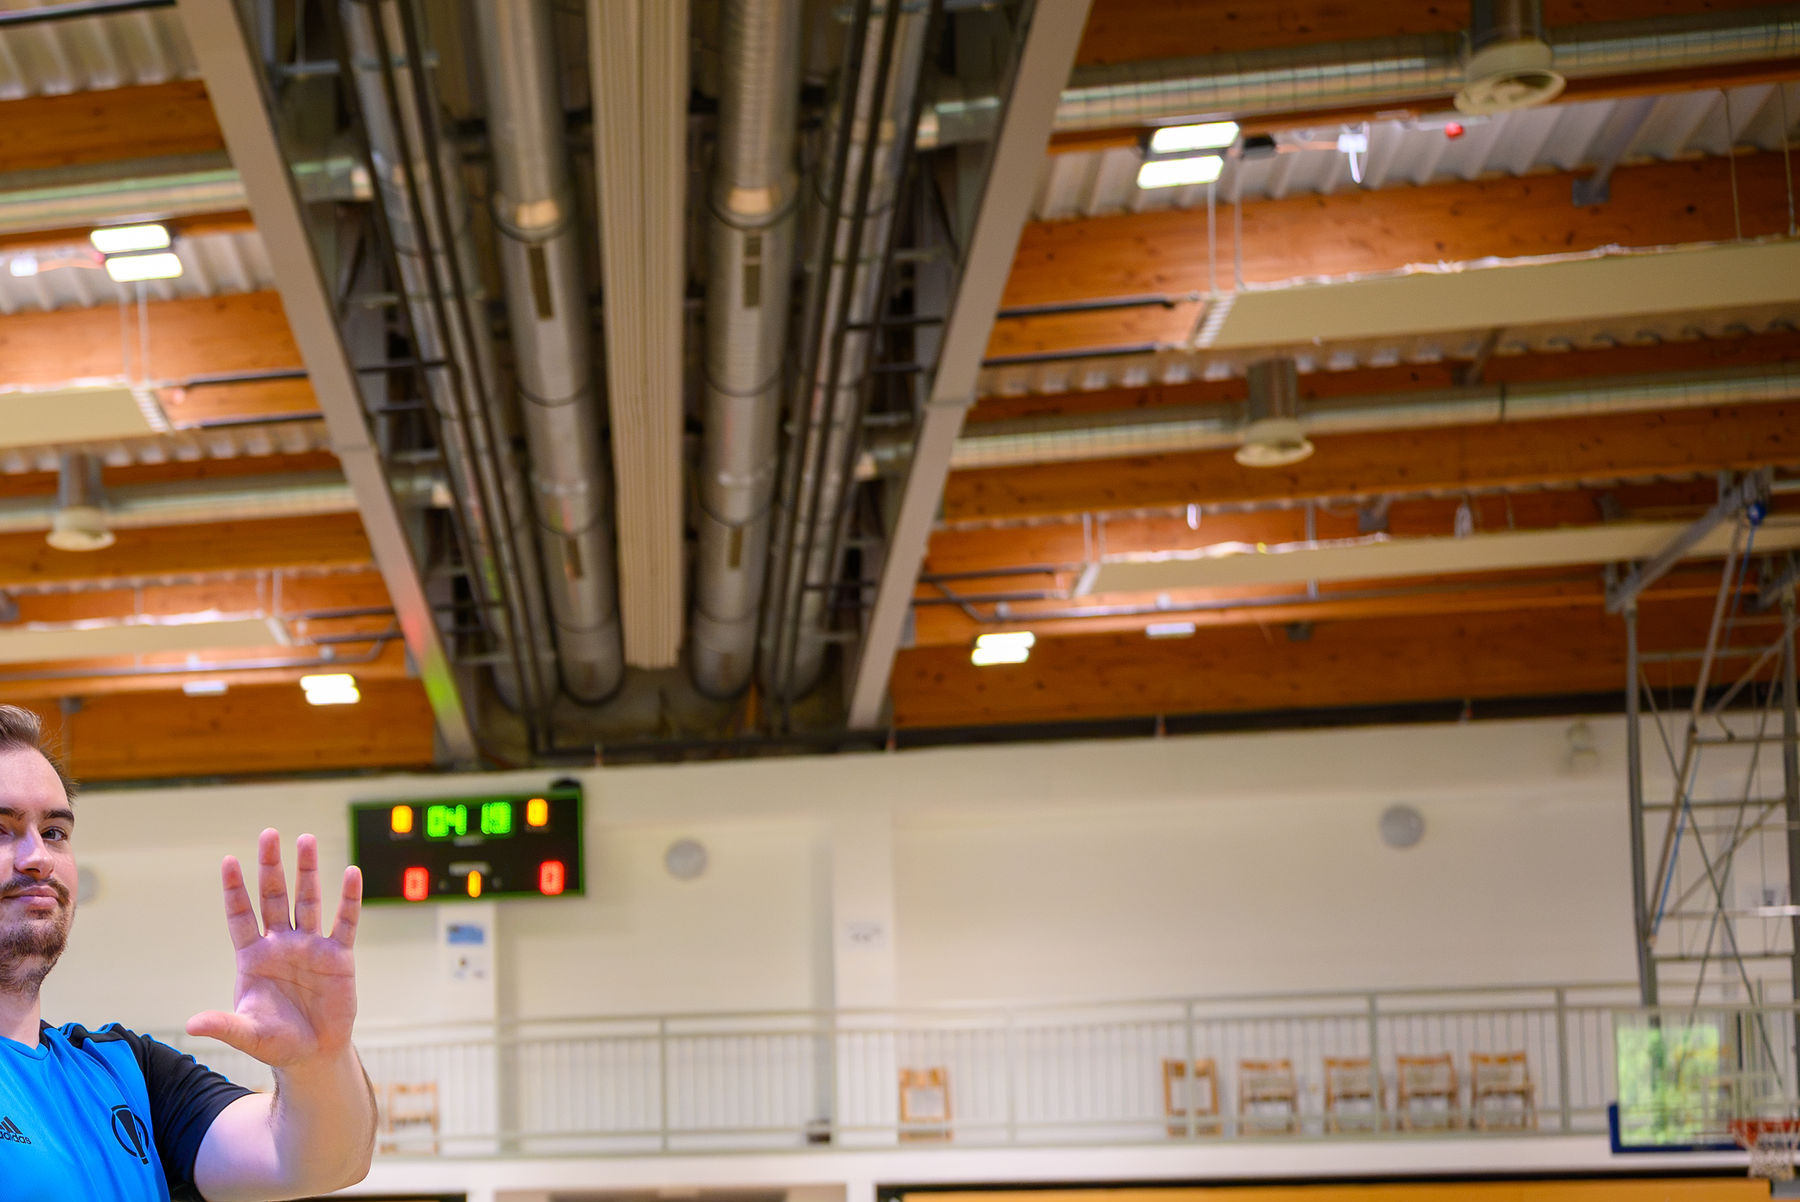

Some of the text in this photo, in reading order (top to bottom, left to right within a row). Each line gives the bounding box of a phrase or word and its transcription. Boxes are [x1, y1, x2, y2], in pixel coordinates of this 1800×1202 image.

[403, 866, 429, 901] 0
[467, 870, 481, 898] 1
[539, 860, 565, 895] 0
